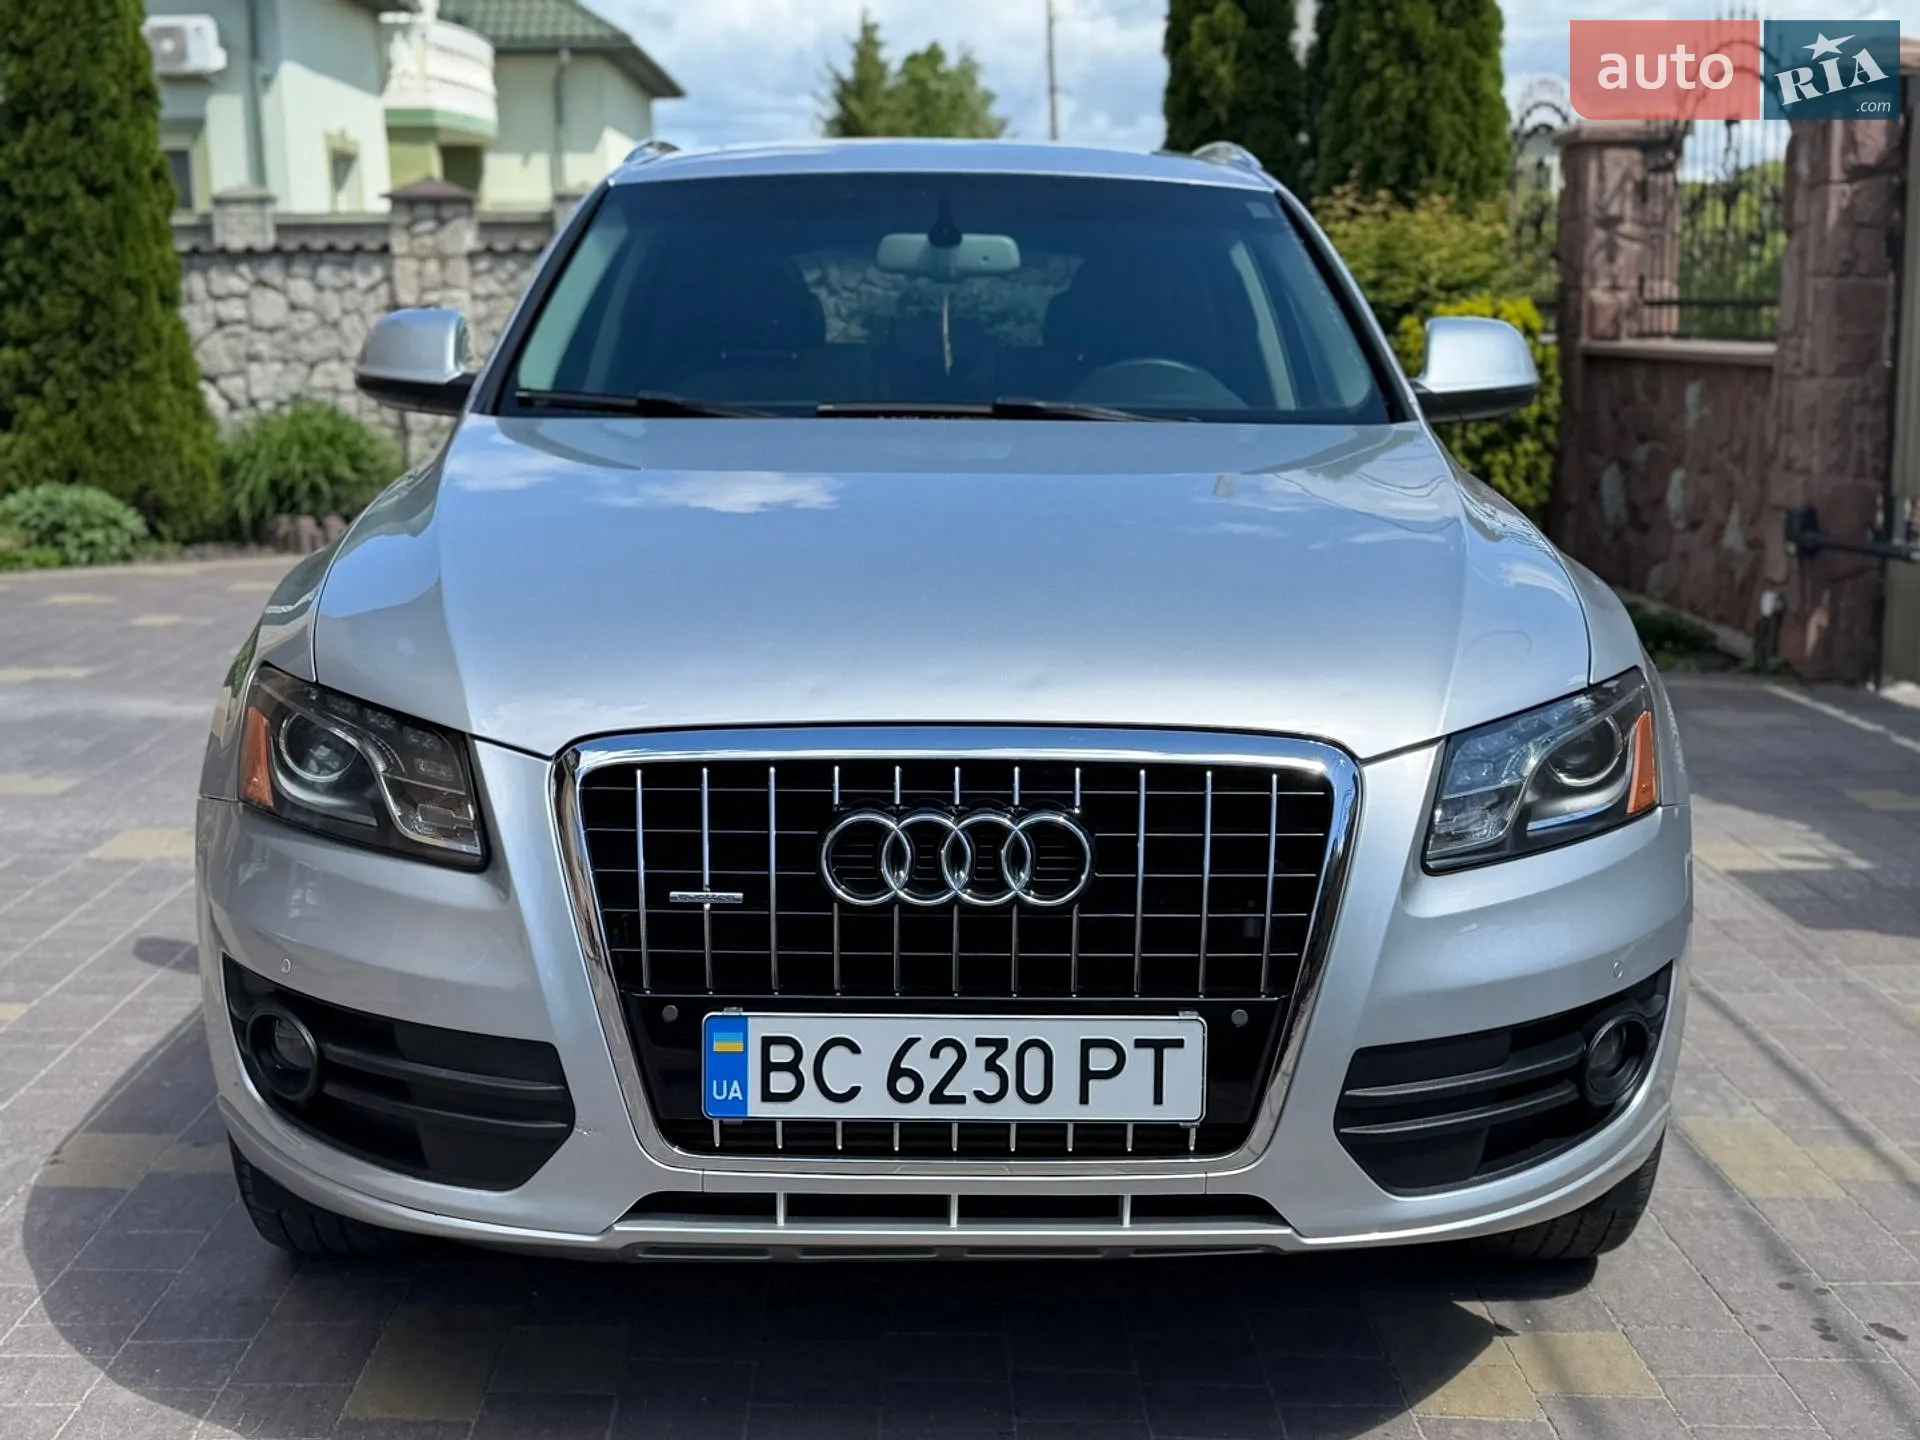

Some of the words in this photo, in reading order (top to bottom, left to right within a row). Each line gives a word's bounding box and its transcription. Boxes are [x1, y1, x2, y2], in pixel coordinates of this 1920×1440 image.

[712, 1080, 743, 1101] UA
[760, 1035, 862, 1103] BC
[886, 1036, 1054, 1105] 6230
[1078, 1038, 1186, 1106] PT
